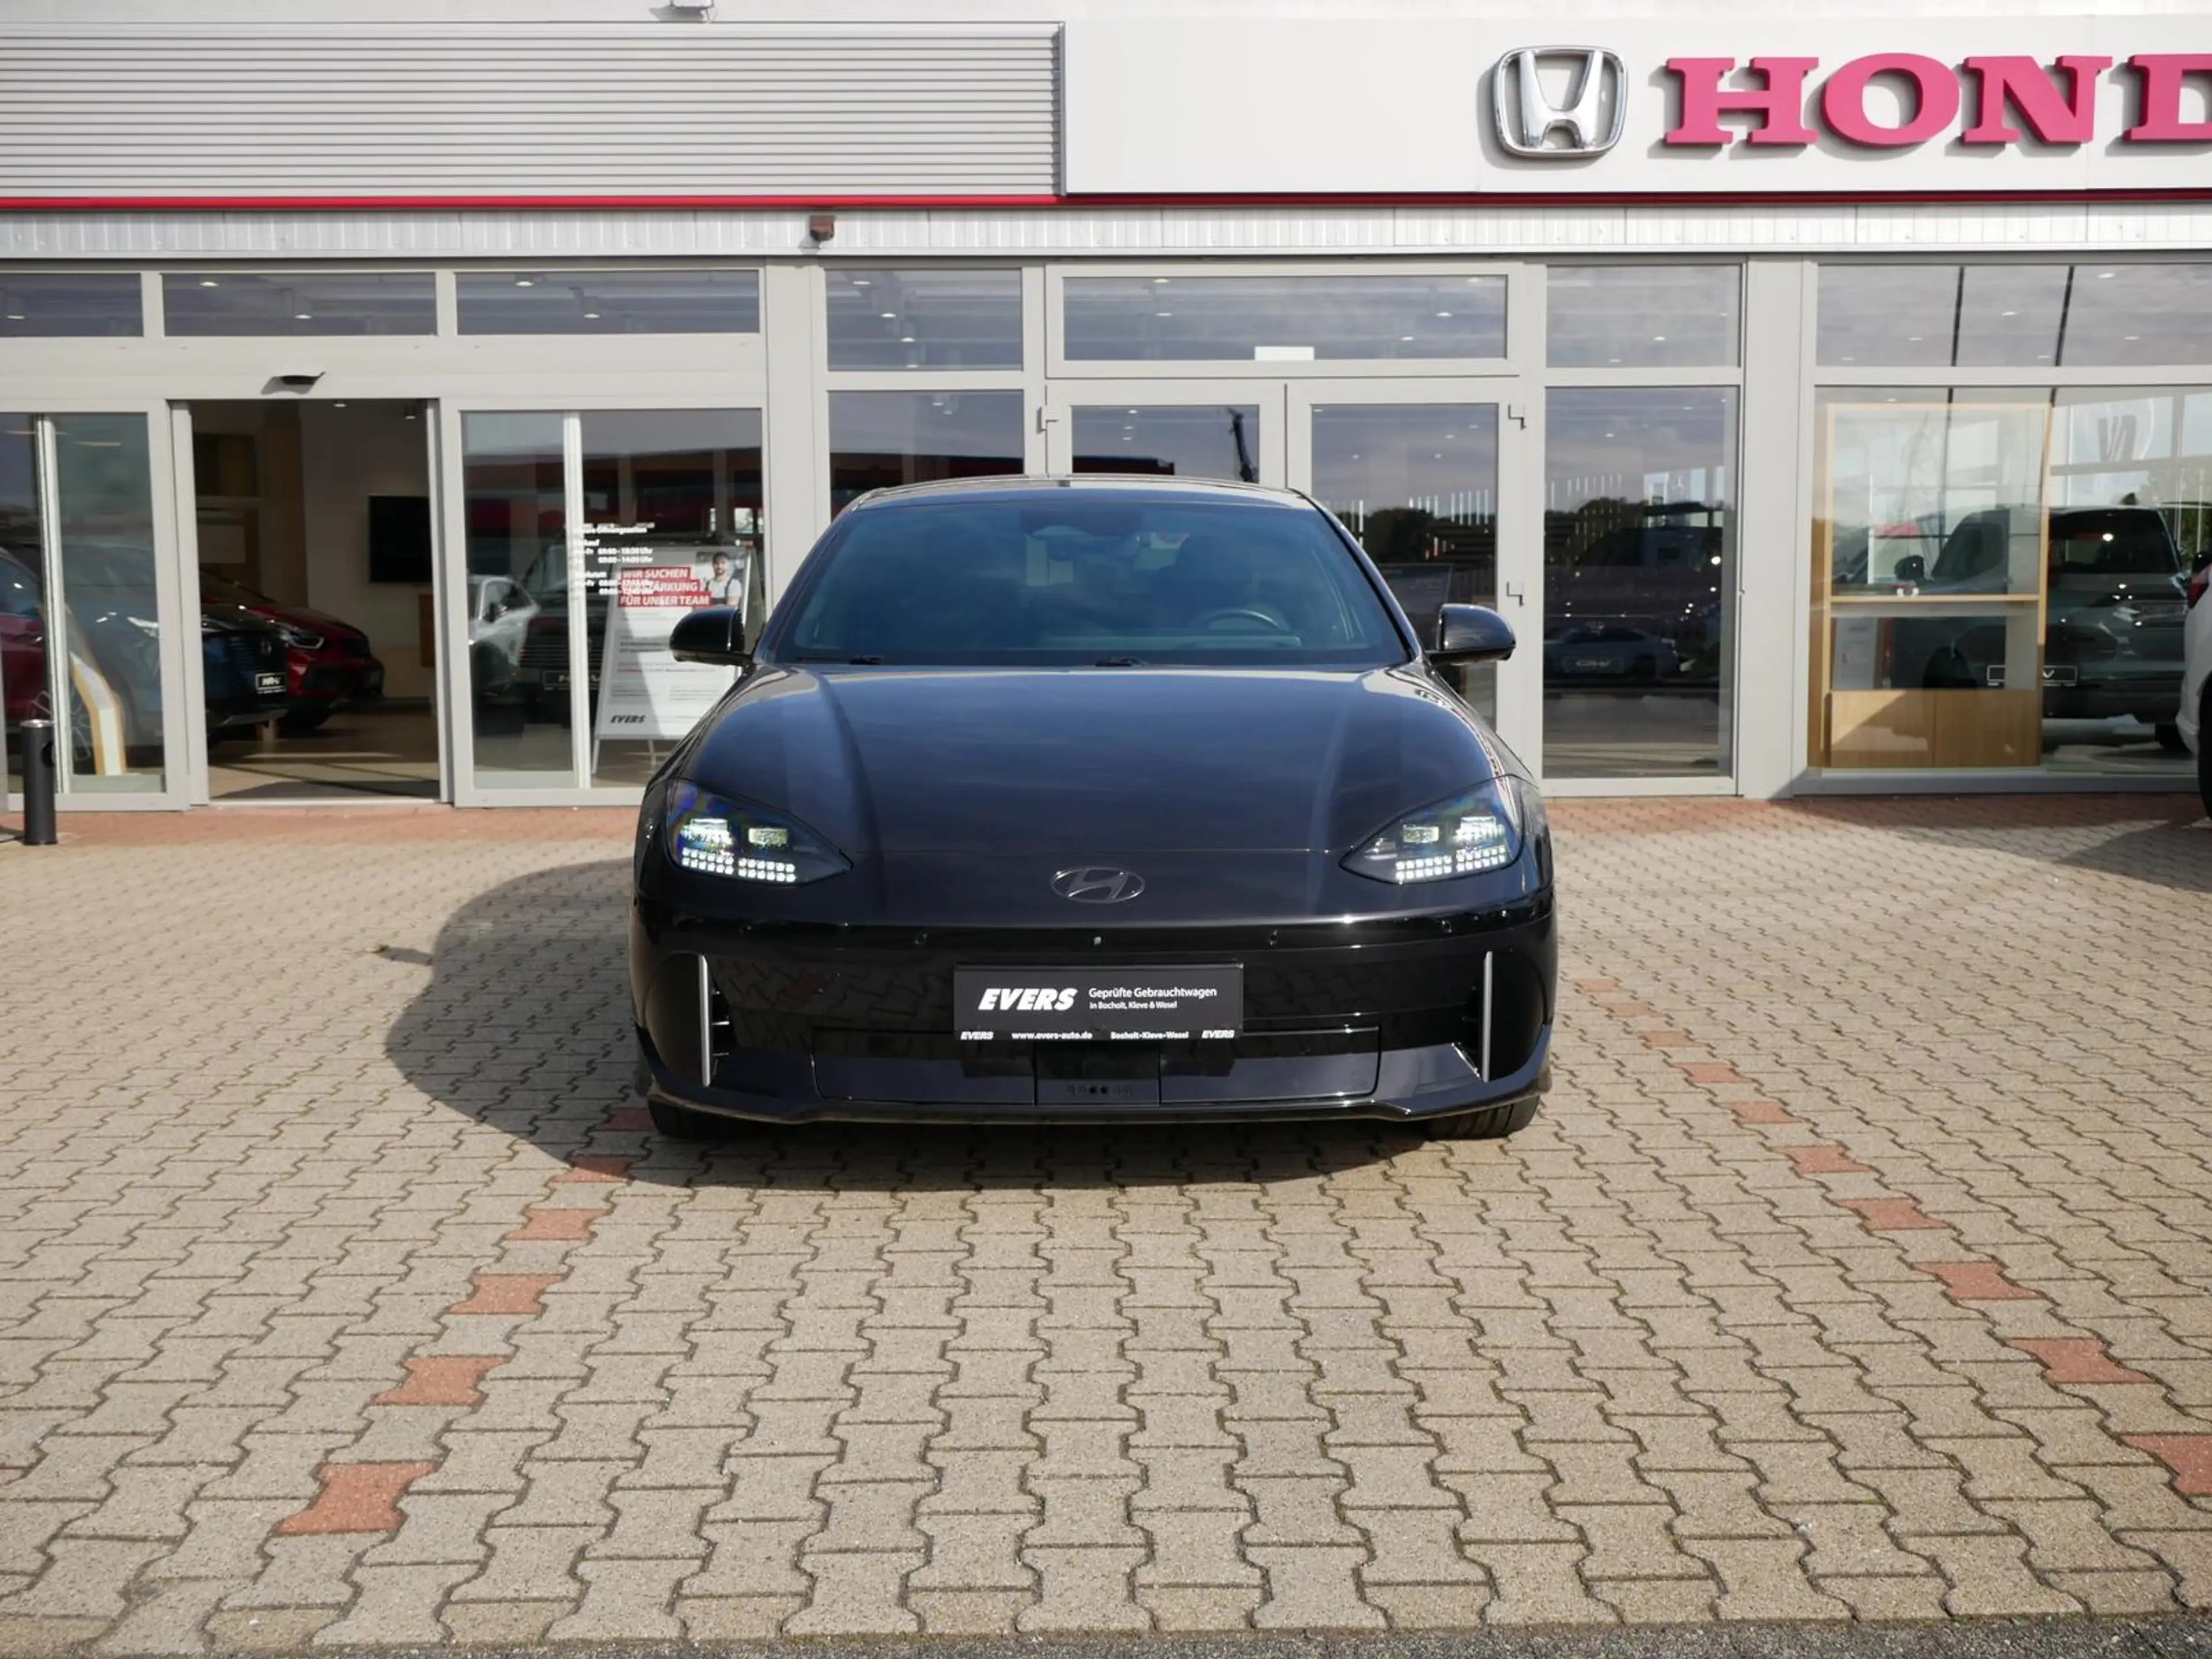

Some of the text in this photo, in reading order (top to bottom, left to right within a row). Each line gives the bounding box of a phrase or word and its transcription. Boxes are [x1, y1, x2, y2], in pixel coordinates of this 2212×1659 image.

[645, 569, 688, 578] SUCHEN
[619, 595, 709, 605] FÜR UNSER TEAM
[1089, 987, 1217, 999] Geprüfte Gebrauchtwagen
[978, 988, 1078, 1010] EVERS
[1156, 1001, 1177, 1009] Wesel
[960, 1032, 994, 1040] EVERS
[1012, 1031, 1093, 1039] www.evers-auto.de
[1202, 1030, 1235, 1039] EVERS
